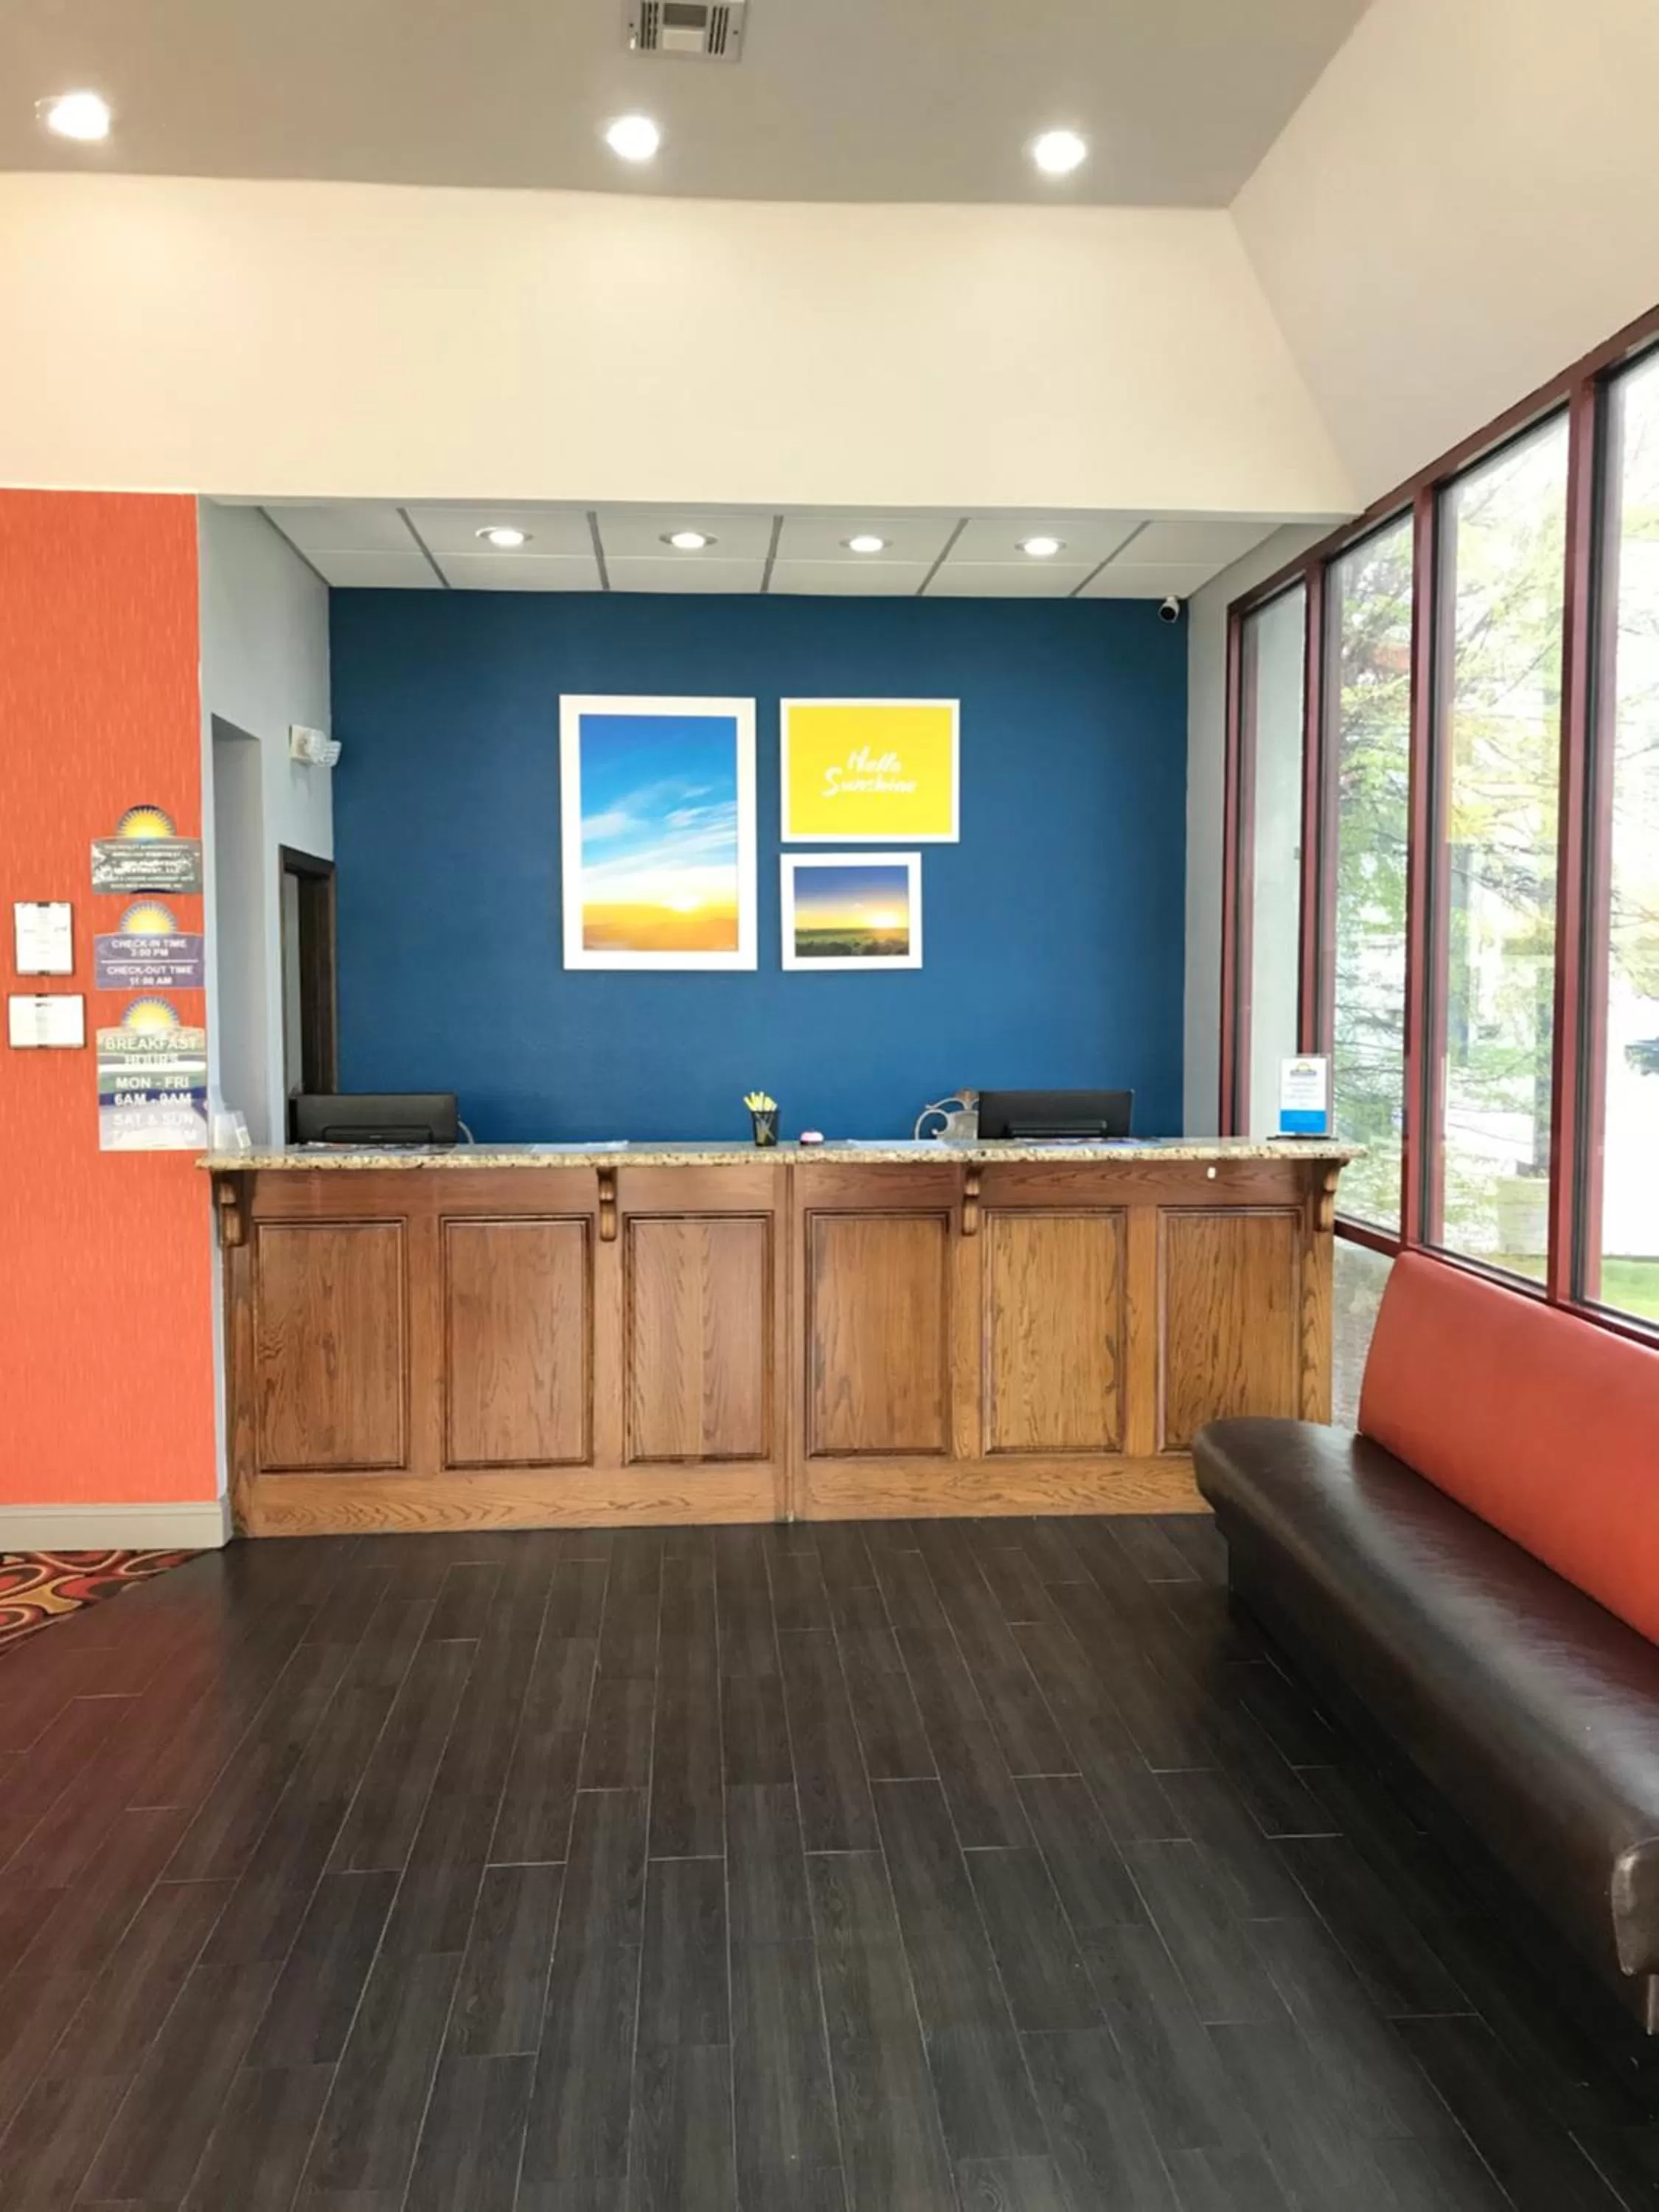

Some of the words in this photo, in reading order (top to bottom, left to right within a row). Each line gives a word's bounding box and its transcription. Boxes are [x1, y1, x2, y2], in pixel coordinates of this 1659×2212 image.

[846, 745, 902, 773] Hello
[821, 765, 917, 797] Sunshine
[111, 939, 160, 948] CHECK-IN
[163, 939, 187, 948] TIME
[153, 948, 169, 956] PM
[170, 965, 193, 974] TIME
[156, 976, 173, 985] AM
[105, 1037, 198, 1051] BREAKFAST
[115, 1076, 151, 1088] MON
[164, 1076, 189, 1088] FRI
[114, 1093, 147, 1105] 6AM
[159, 1092, 192, 1105] 9AM
